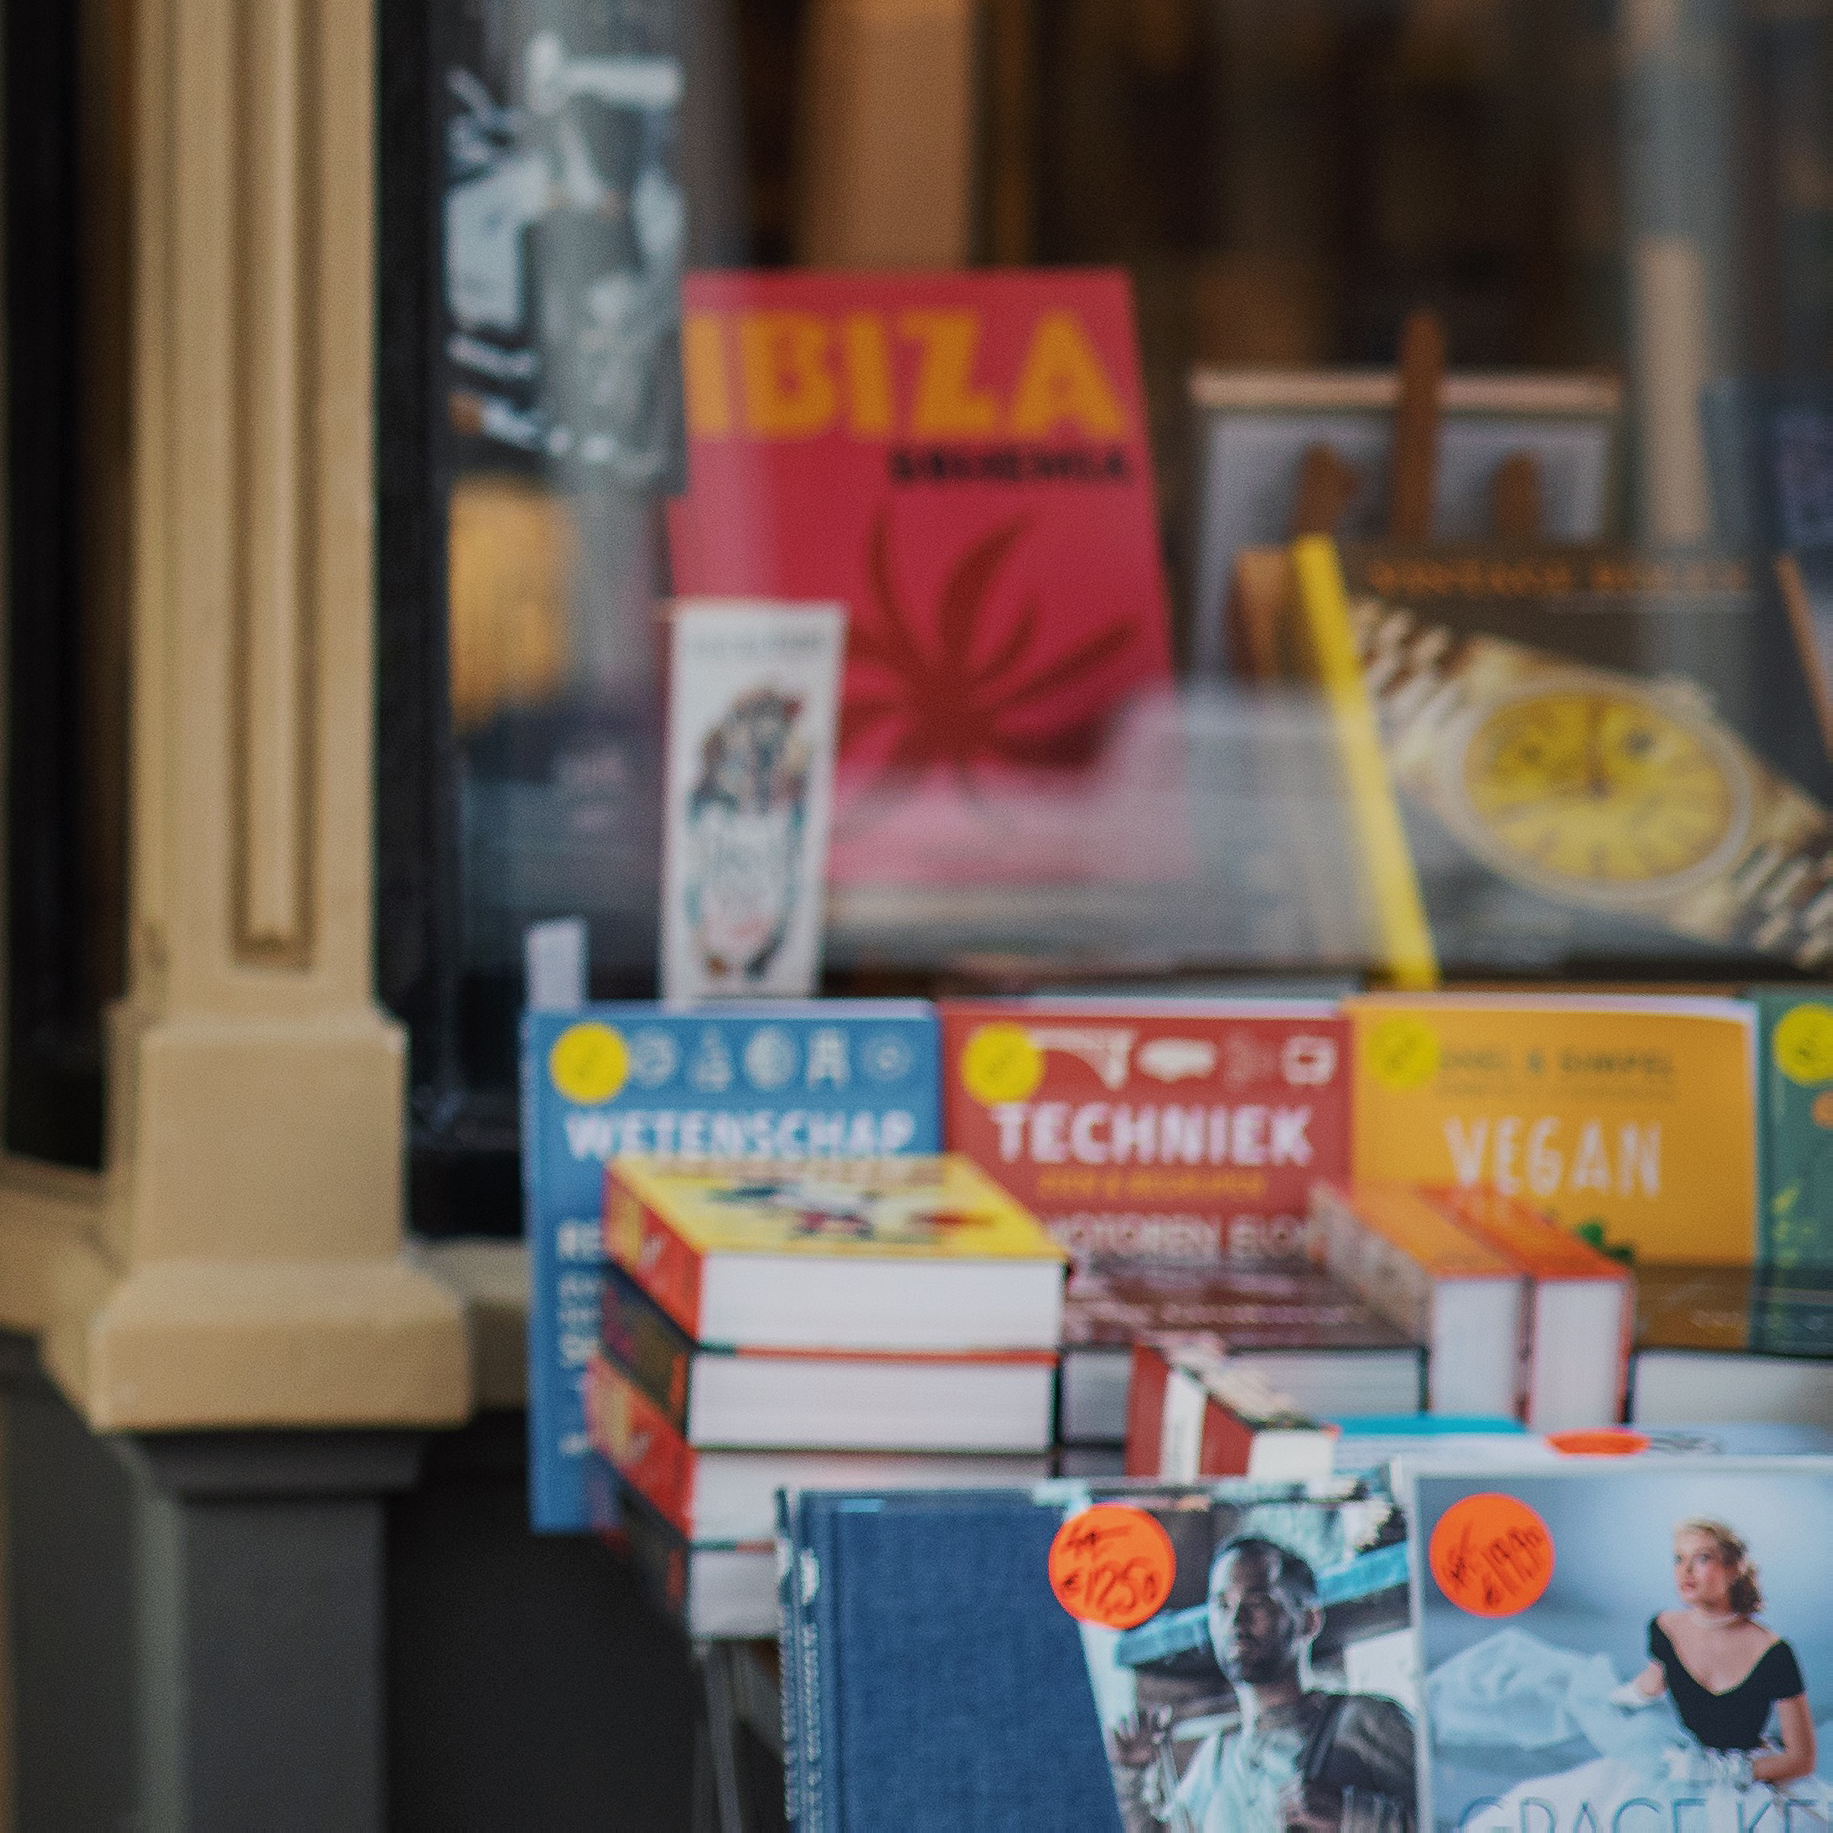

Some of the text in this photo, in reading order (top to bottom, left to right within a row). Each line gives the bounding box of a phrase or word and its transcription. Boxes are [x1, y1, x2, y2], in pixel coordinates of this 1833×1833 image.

[683, 309, 1127, 442] IBIZA
[564, 1108, 917, 1163] WETENSCHAP
[990, 1100, 1314, 1166] TECHNIEK
[1443, 1116, 1661, 1200] VEGAN
